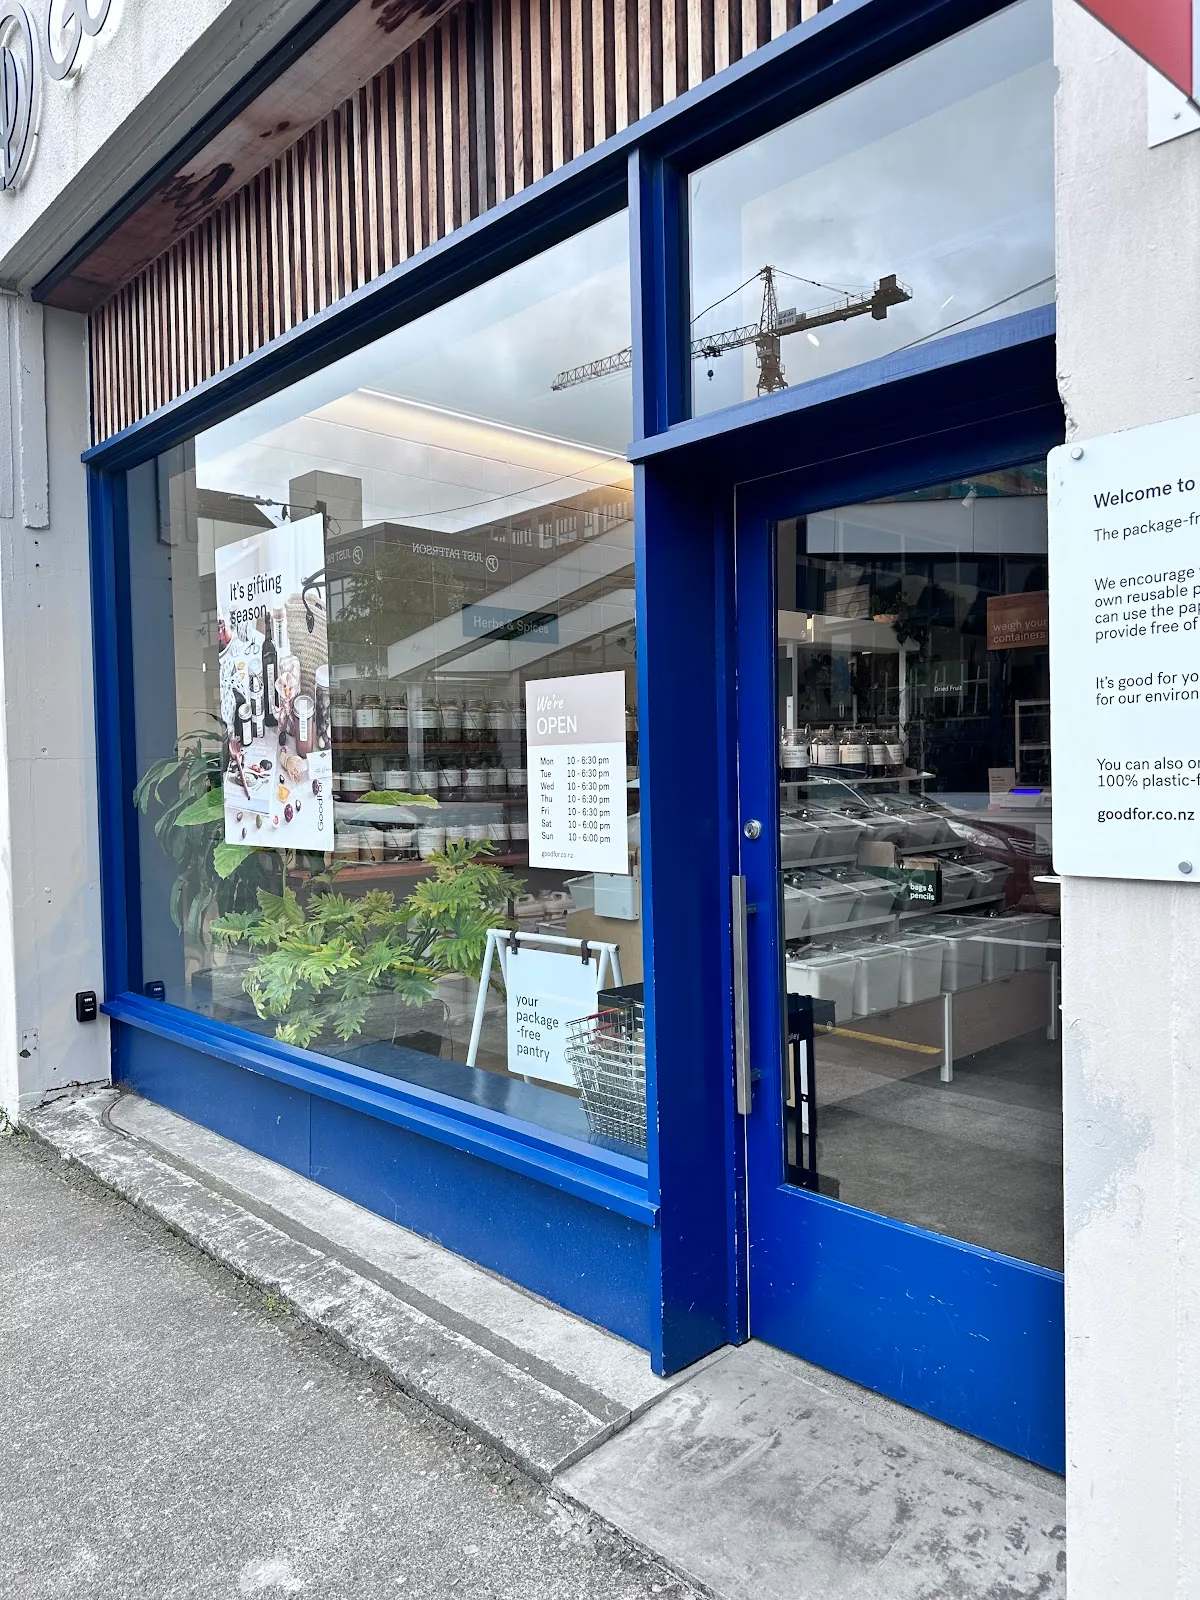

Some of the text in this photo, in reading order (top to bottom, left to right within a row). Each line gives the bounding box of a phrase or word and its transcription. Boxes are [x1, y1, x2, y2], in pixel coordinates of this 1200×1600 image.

[1093, 478, 1196, 509] Welcome to
[1093, 528, 1119, 542] The
[1094, 568, 1195, 591] We encourage
[229, 573, 283, 602] It's gifting
[1094, 595, 1123, 608] own
[1127, 584, 1188, 604] reusable
[229, 604, 268, 625] season
[1095, 612, 1119, 624] can
[1123, 609, 1147, 621] use
[1151, 603, 1174, 618] the
[473, 615, 505, 630] Herbs
[507, 618, 515, 631] &
[993, 620, 1022, 633] weigh
[1095, 616, 1199, 644] provide free of
[993, 631, 1046, 644] containers
[934, 684, 949, 692] Dried
[1096, 671, 1199, 691] It's good for yo
[536, 694, 565, 713] We're
[1096, 688, 1200, 706] for our environ
[536, 716, 578, 736] OPEN
[540, 757, 554, 766] Mon
[567, 756, 576, 765] 10
[581, 755, 597, 765] 6:30
[598, 757, 610, 767] pm
[1097, 758, 1121, 771] You
[1125, 760, 1150, 771] can
[1154, 756, 1184, 770] also
[540, 769, 552, 778] Tue
[567, 769, 576, 778] 10
[581, 769, 597, 778] 6:30
[598, 769, 610, 779] pm
[1098, 773, 1139, 788] 100%
[540, 782, 555, 790] Wed
[567, 782, 576, 791] 10
[581, 782, 597, 791] 6:30
[598, 783, 610, 792] pm
[540, 794, 553, 803] Thu
[567, 794, 576, 803] 10
[582, 794, 598, 804] 6:30
[599, 796, 610, 805] pm
[541, 806, 550, 815] Fri
[568, 807, 577, 816] 10
[582, 807, 598, 817] 6:30
[599, 809, 611, 818] pm
[1097, 807, 1195, 823] goodfor.co.nz
[541, 819, 552, 828] Sat
[568, 820, 577, 829] 10
[582, 820, 598, 830] 6:00
[599, 823, 611, 831] pm
[541, 831, 554, 840] Sun
[568, 832, 577, 842] 10
[582, 833, 598, 843] 6:00
[599, 835, 611, 844] pm
[910, 882, 934, 893] bags &
[910, 892, 935, 901] pencils
[516, 994, 539, 1007] your
[516, 1011, 559, 1030] package
[516, 1025, 541, 1041] -free
[516, 1044, 550, 1063] pantry
